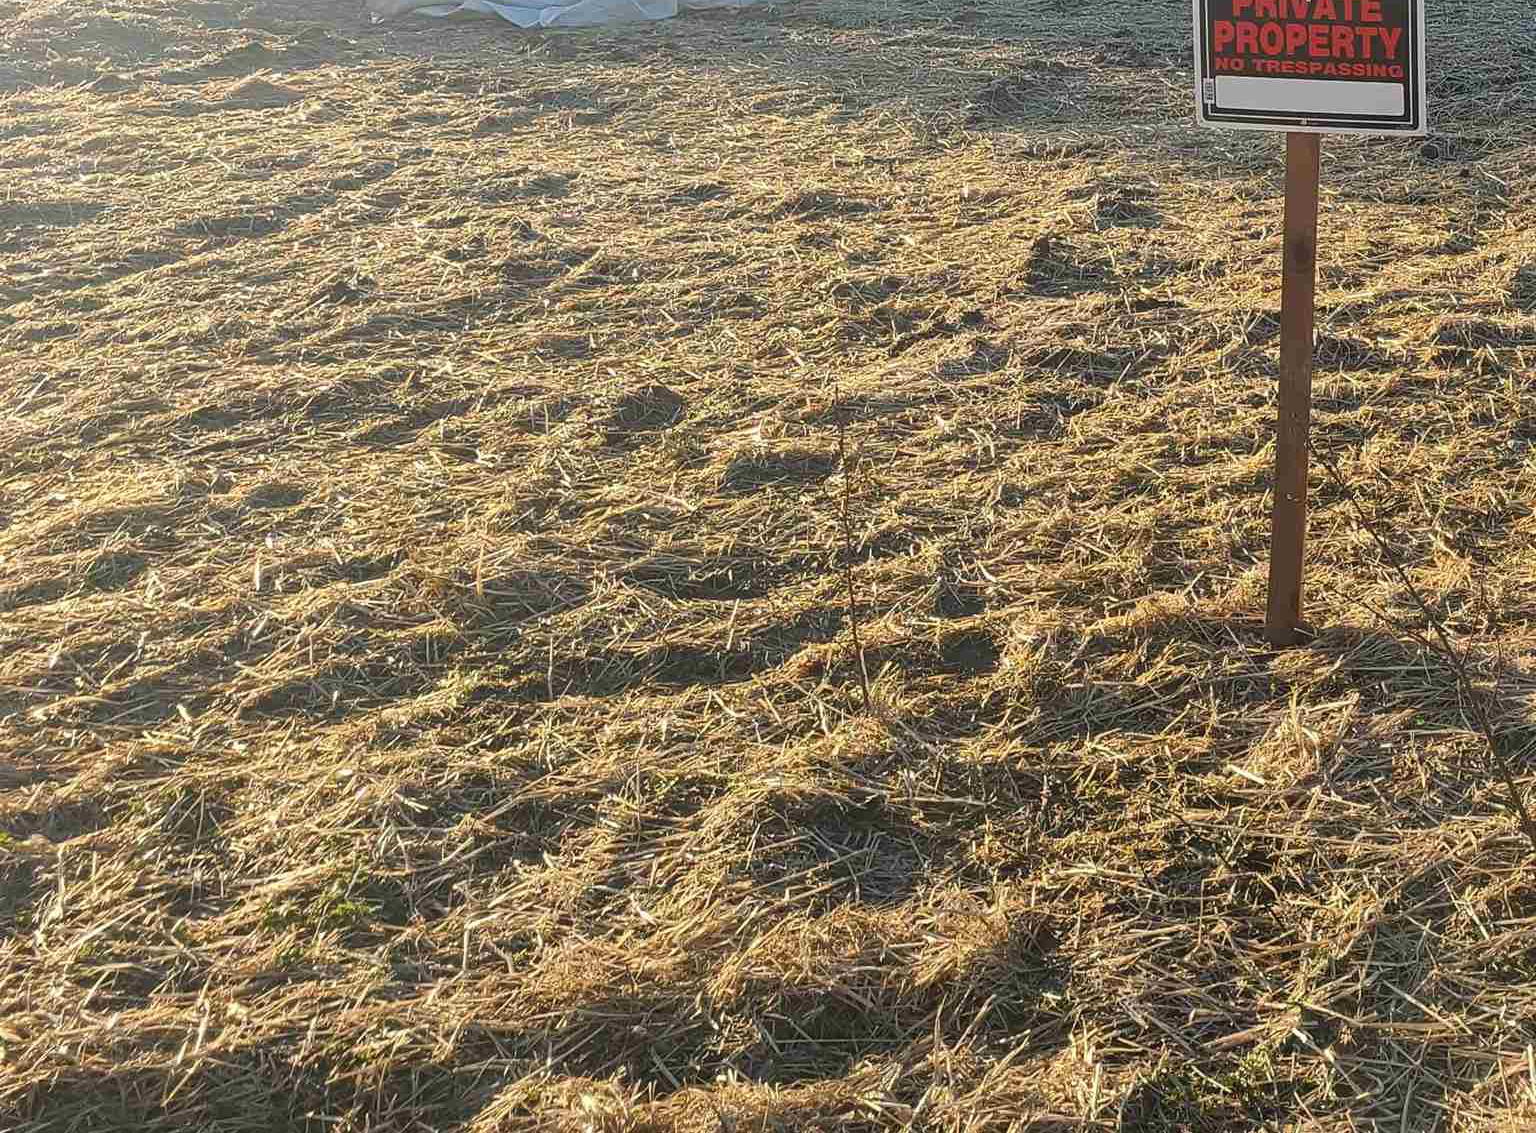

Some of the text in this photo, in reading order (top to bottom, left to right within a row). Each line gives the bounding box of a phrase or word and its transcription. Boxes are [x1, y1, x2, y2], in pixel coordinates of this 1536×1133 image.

[1214, 20, 1402, 59] PROPERTY
[1215, 58, 1404, 78] NO TRESPASSING
